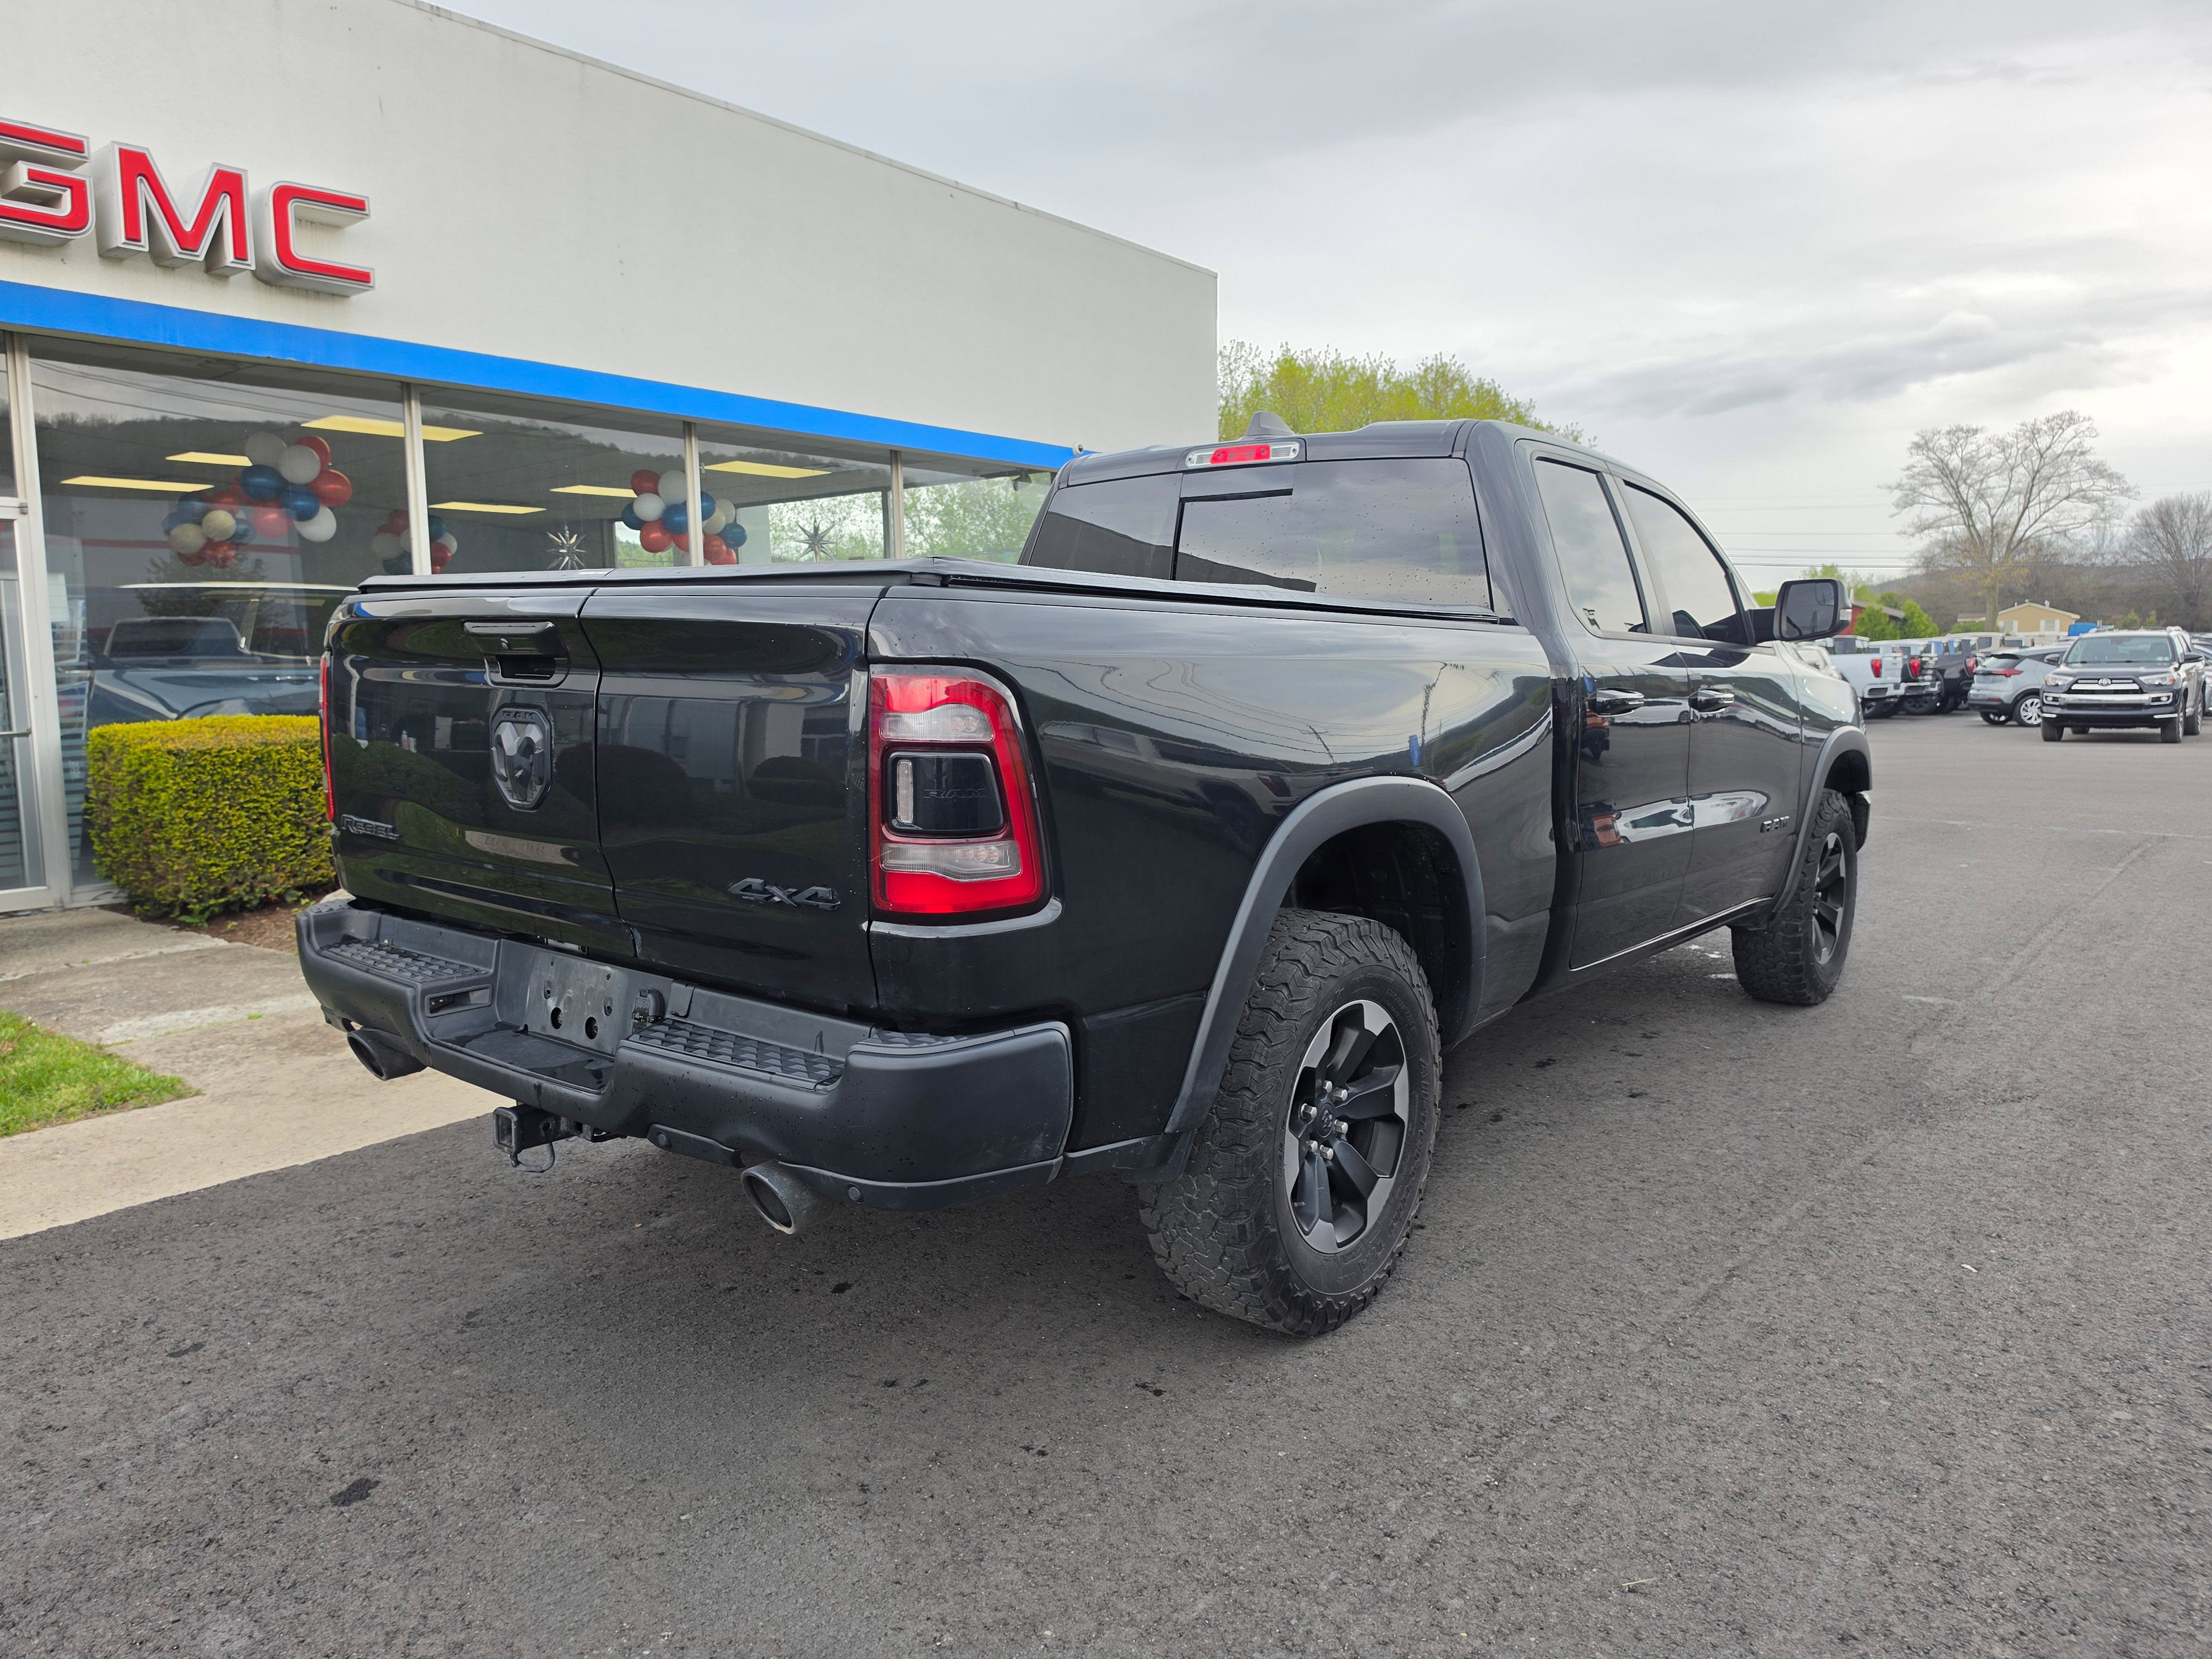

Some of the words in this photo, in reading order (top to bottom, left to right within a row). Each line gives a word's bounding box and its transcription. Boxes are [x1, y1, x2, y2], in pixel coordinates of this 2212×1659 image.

[0, 117, 375, 294] GMC
[502, 711, 536, 720] RAM
[924, 789, 987, 798] RAM
[341, 813, 401, 840] REBEL
